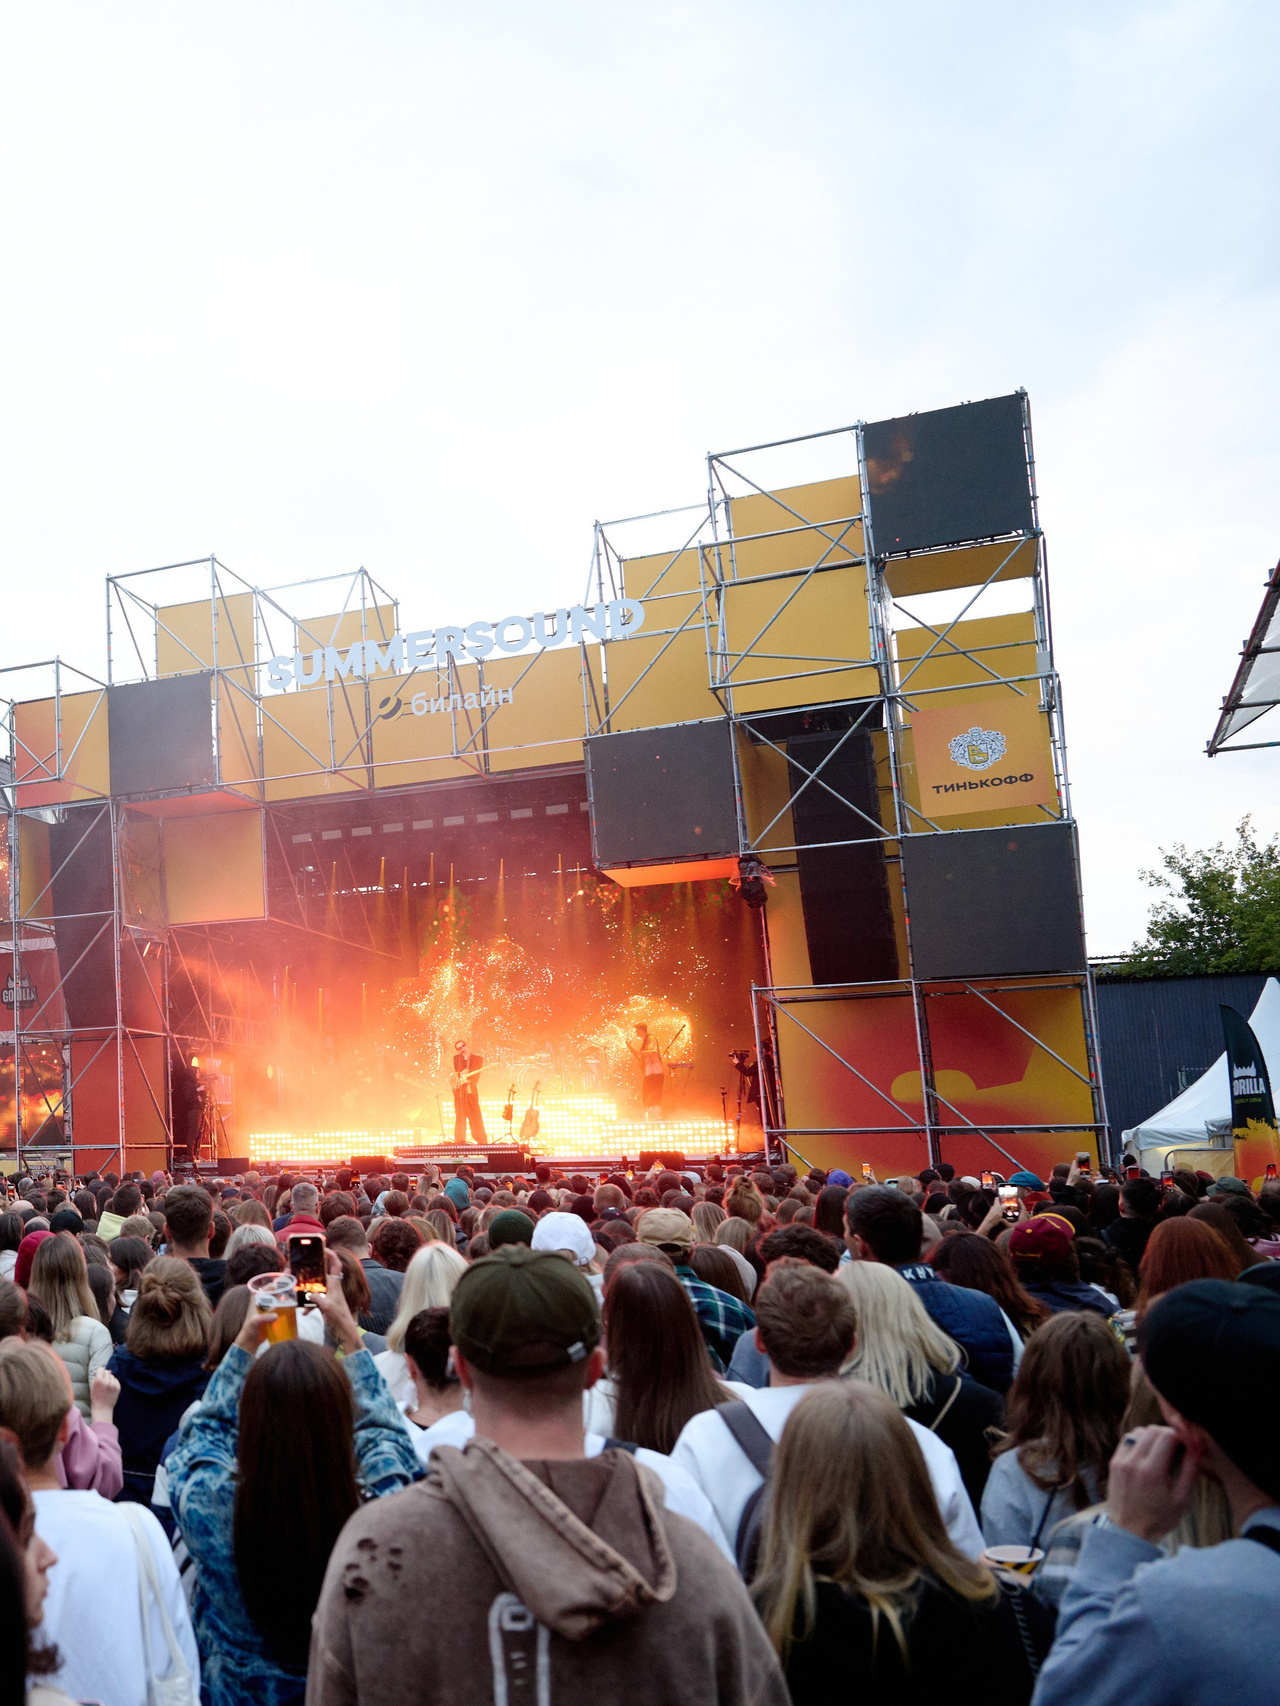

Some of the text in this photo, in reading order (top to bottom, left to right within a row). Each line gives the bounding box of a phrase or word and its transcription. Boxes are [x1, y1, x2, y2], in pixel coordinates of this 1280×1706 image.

[267, 598, 645, 690] SUMMERSOUND
[411, 684, 514, 717] билайн
[932, 773, 1034, 794] ТИНЬКОФФ
[2, 987, 37, 1003] GOILLA
[1233, 1077, 1266, 1096] ORILLA
